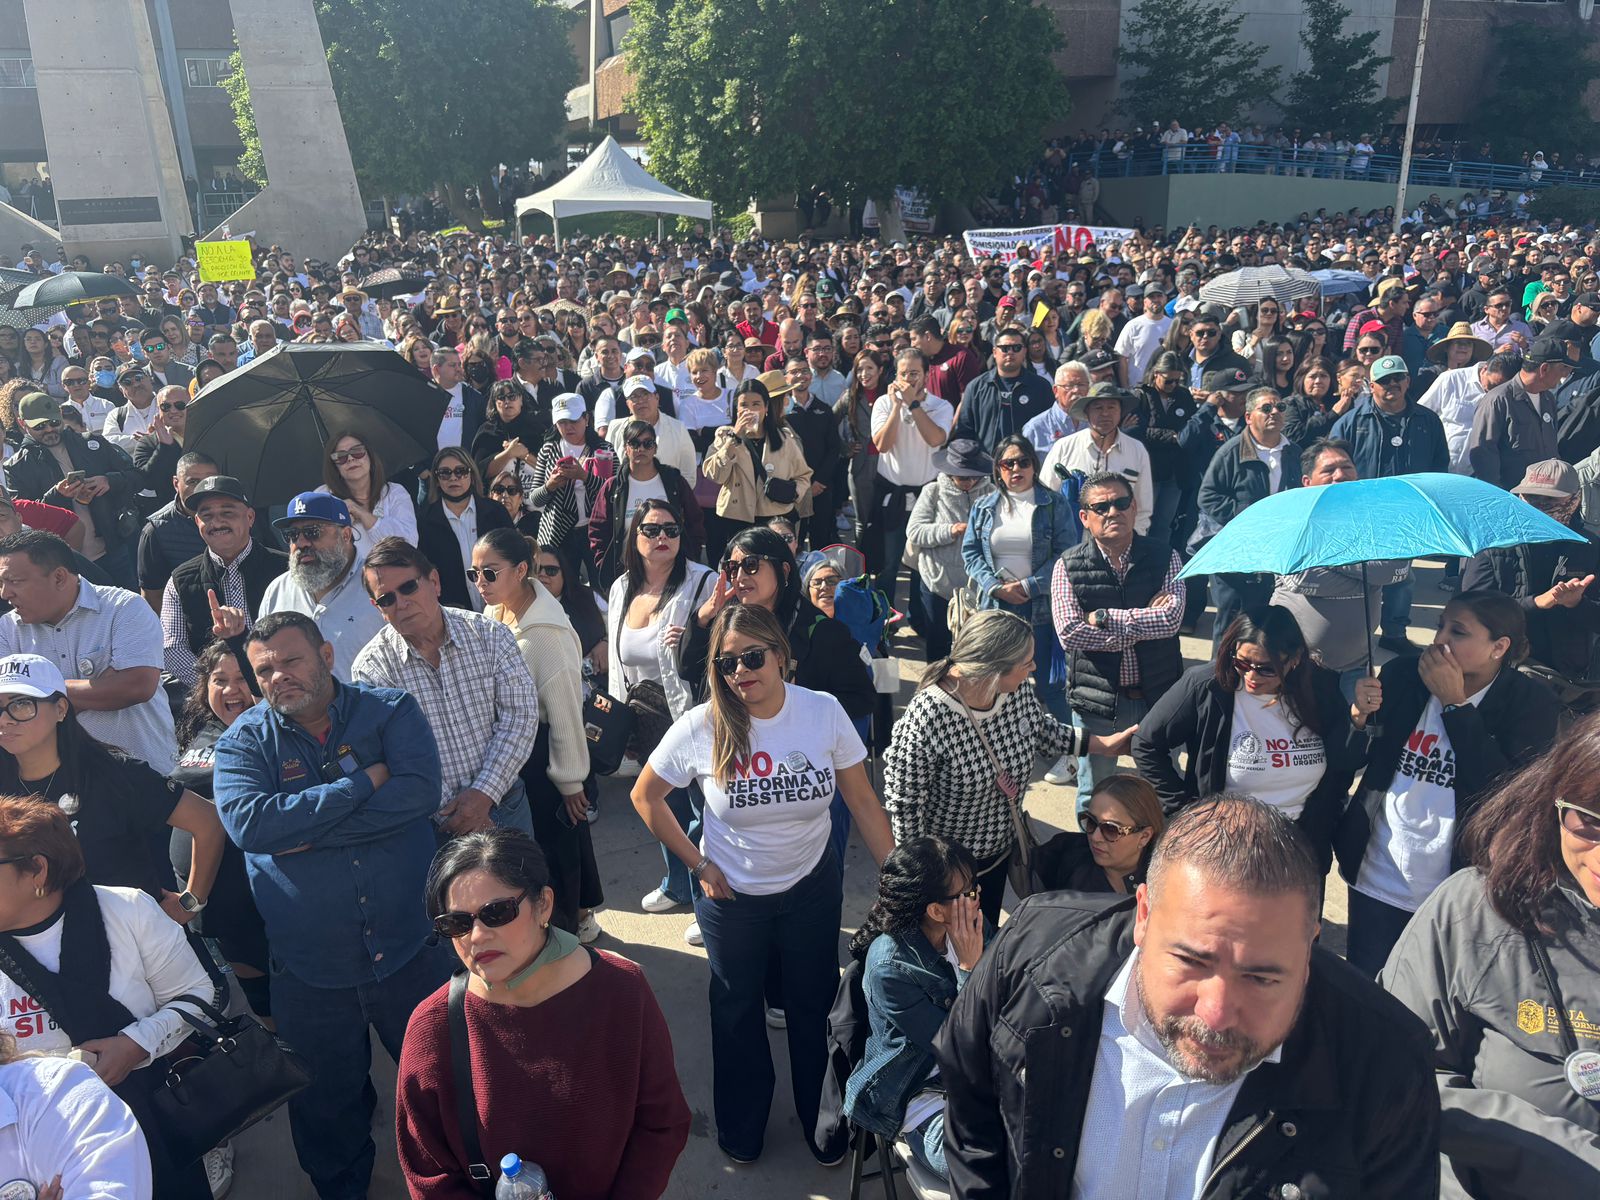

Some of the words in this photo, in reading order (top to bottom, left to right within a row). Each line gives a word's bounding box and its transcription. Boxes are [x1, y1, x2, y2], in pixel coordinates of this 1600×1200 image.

[1055, 226, 1093, 255] NO
[201, 246, 214, 256] NO
[294, 497, 306, 515] LA
[1266, 738, 1290, 751] NO
[1429, 748, 1441, 760] A
[734, 751, 773, 779] NO
[777, 763, 790, 775] A
[1271, 753, 1291, 768] SI
[725, 773, 813, 794] REFORMA
[814, 767, 833, 784] DE
[729, 781, 833, 809] ISSSTECALI
[10, 996, 42, 1015] NO
[15, 1014, 43, 1038] SI
